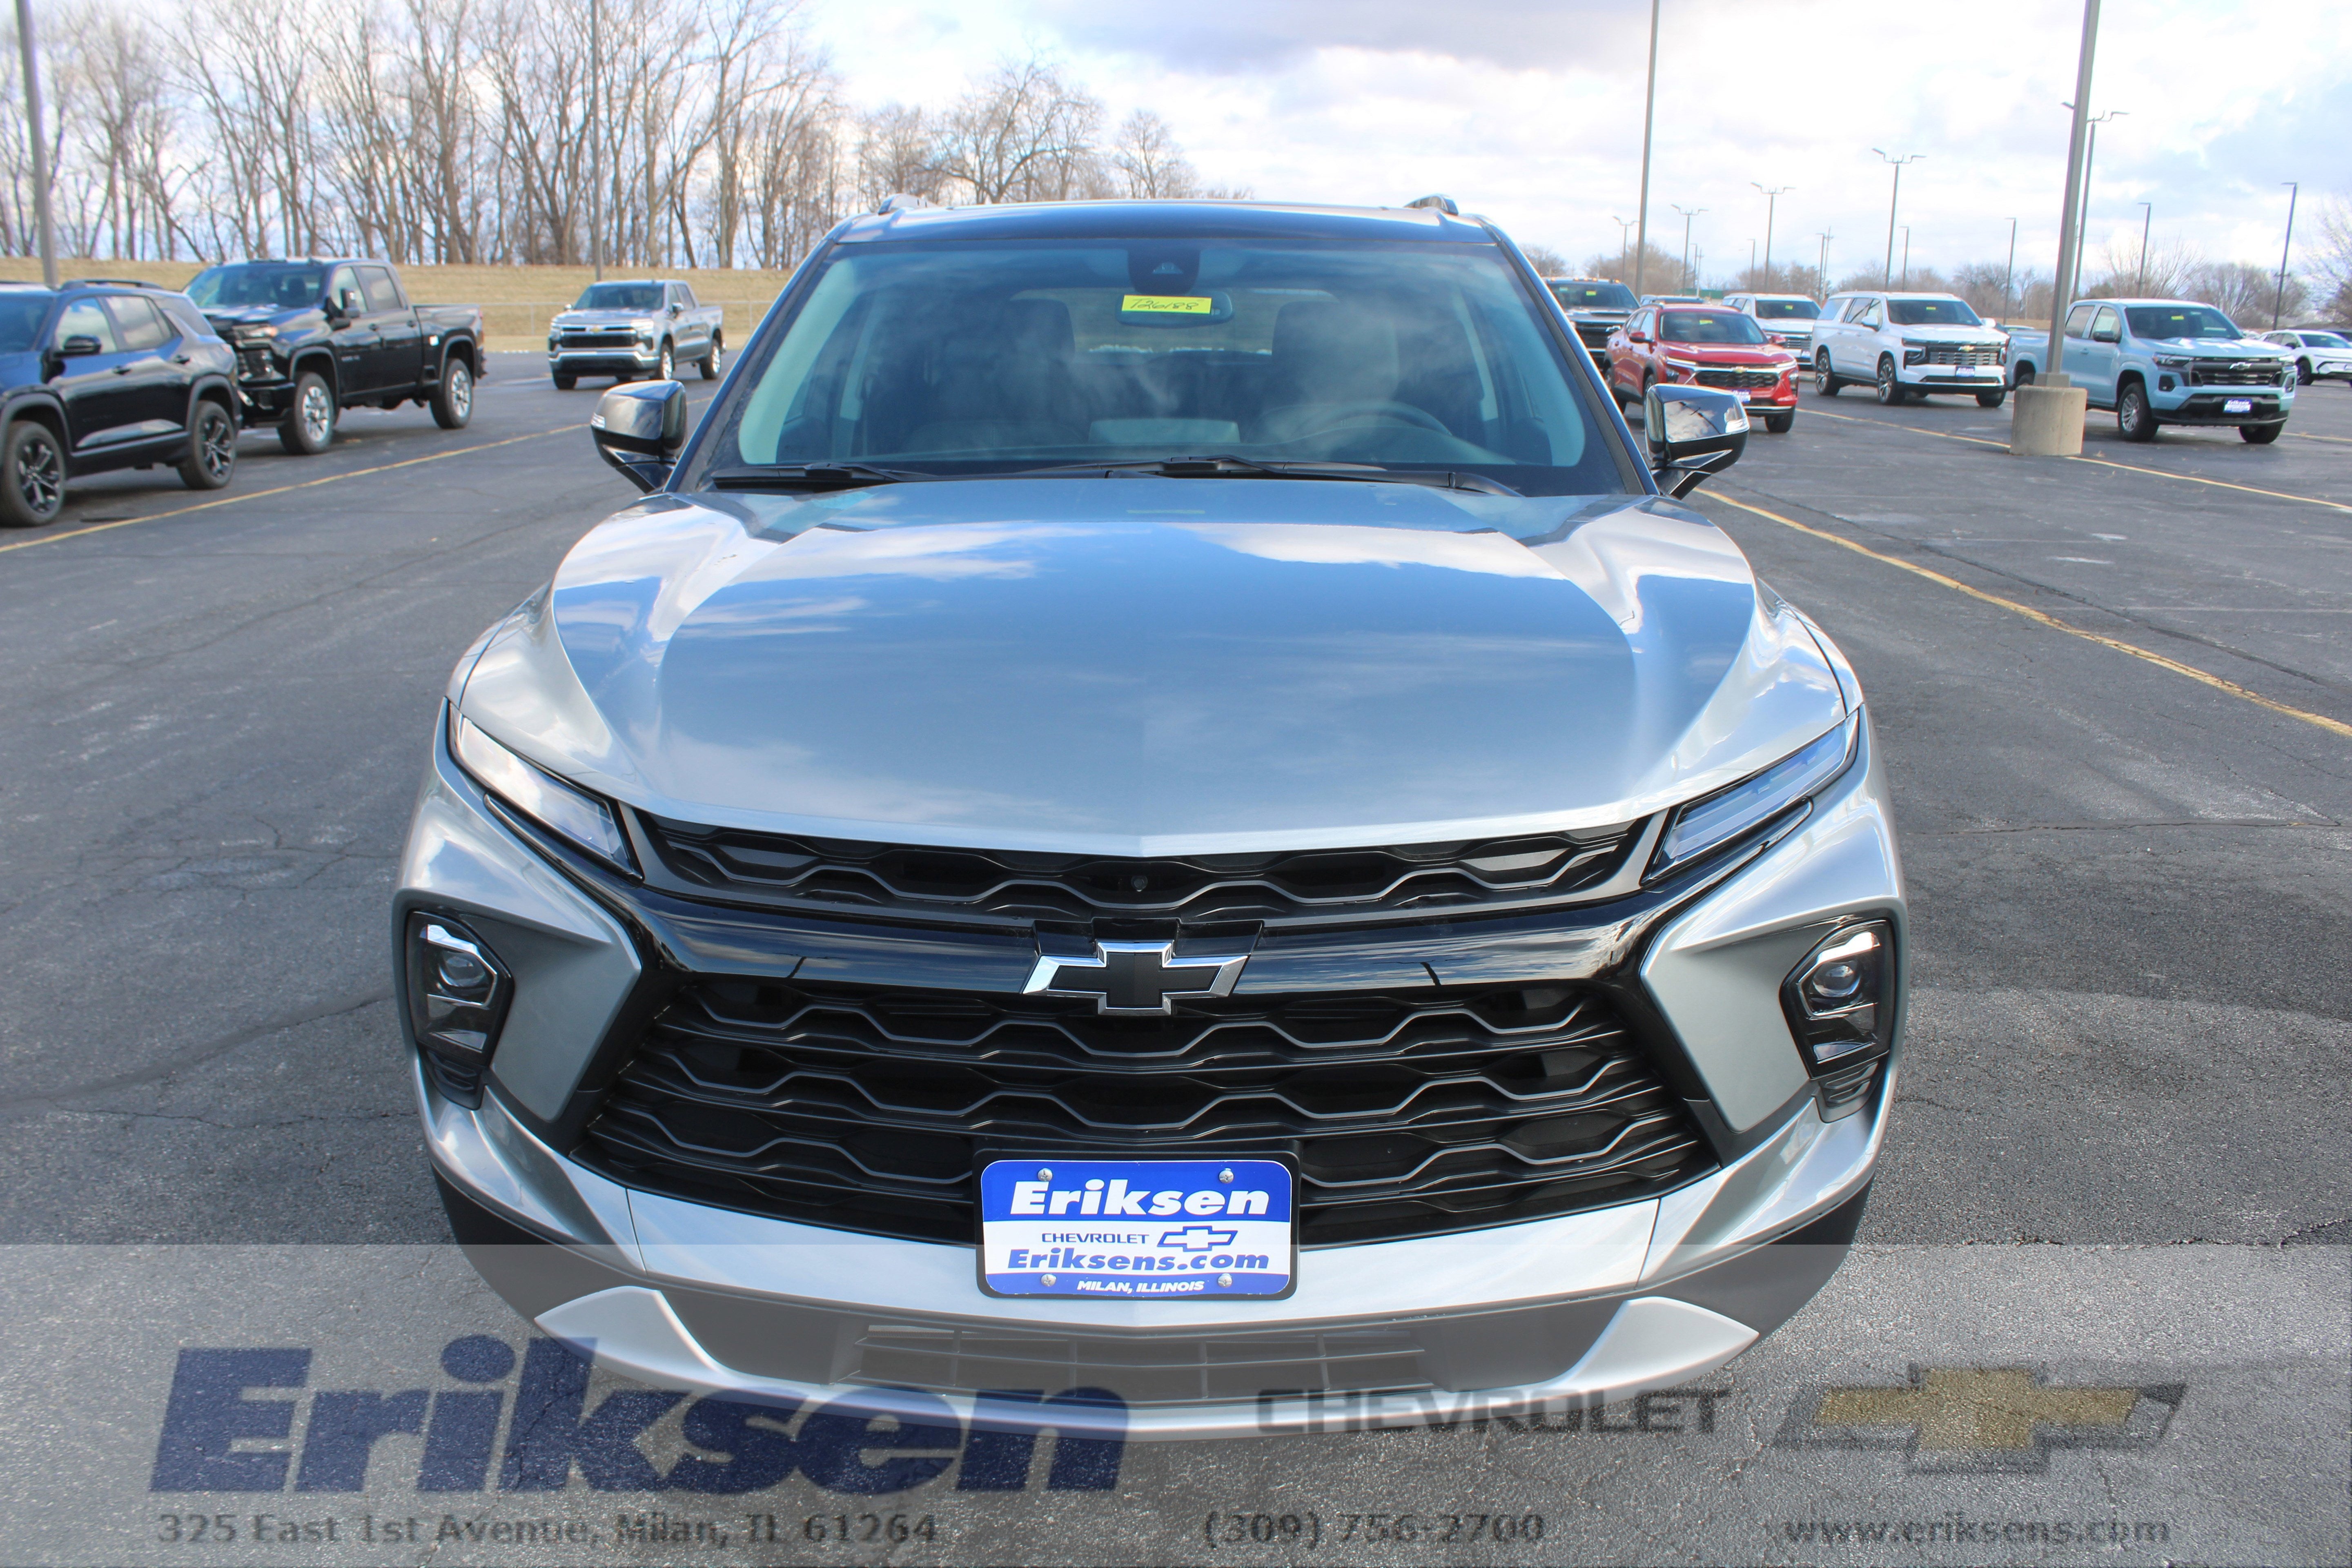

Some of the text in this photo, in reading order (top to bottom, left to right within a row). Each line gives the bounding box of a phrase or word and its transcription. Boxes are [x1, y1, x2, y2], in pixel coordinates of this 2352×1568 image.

[1010, 1178, 1270, 1216] Eriksen
[1042, 1233, 1149, 1244] CHEVROLET
[1007, 1247, 1269, 1271] Eriksens.com
[1077, 1281, 1205, 1294] MILAN, ILLINOIS
